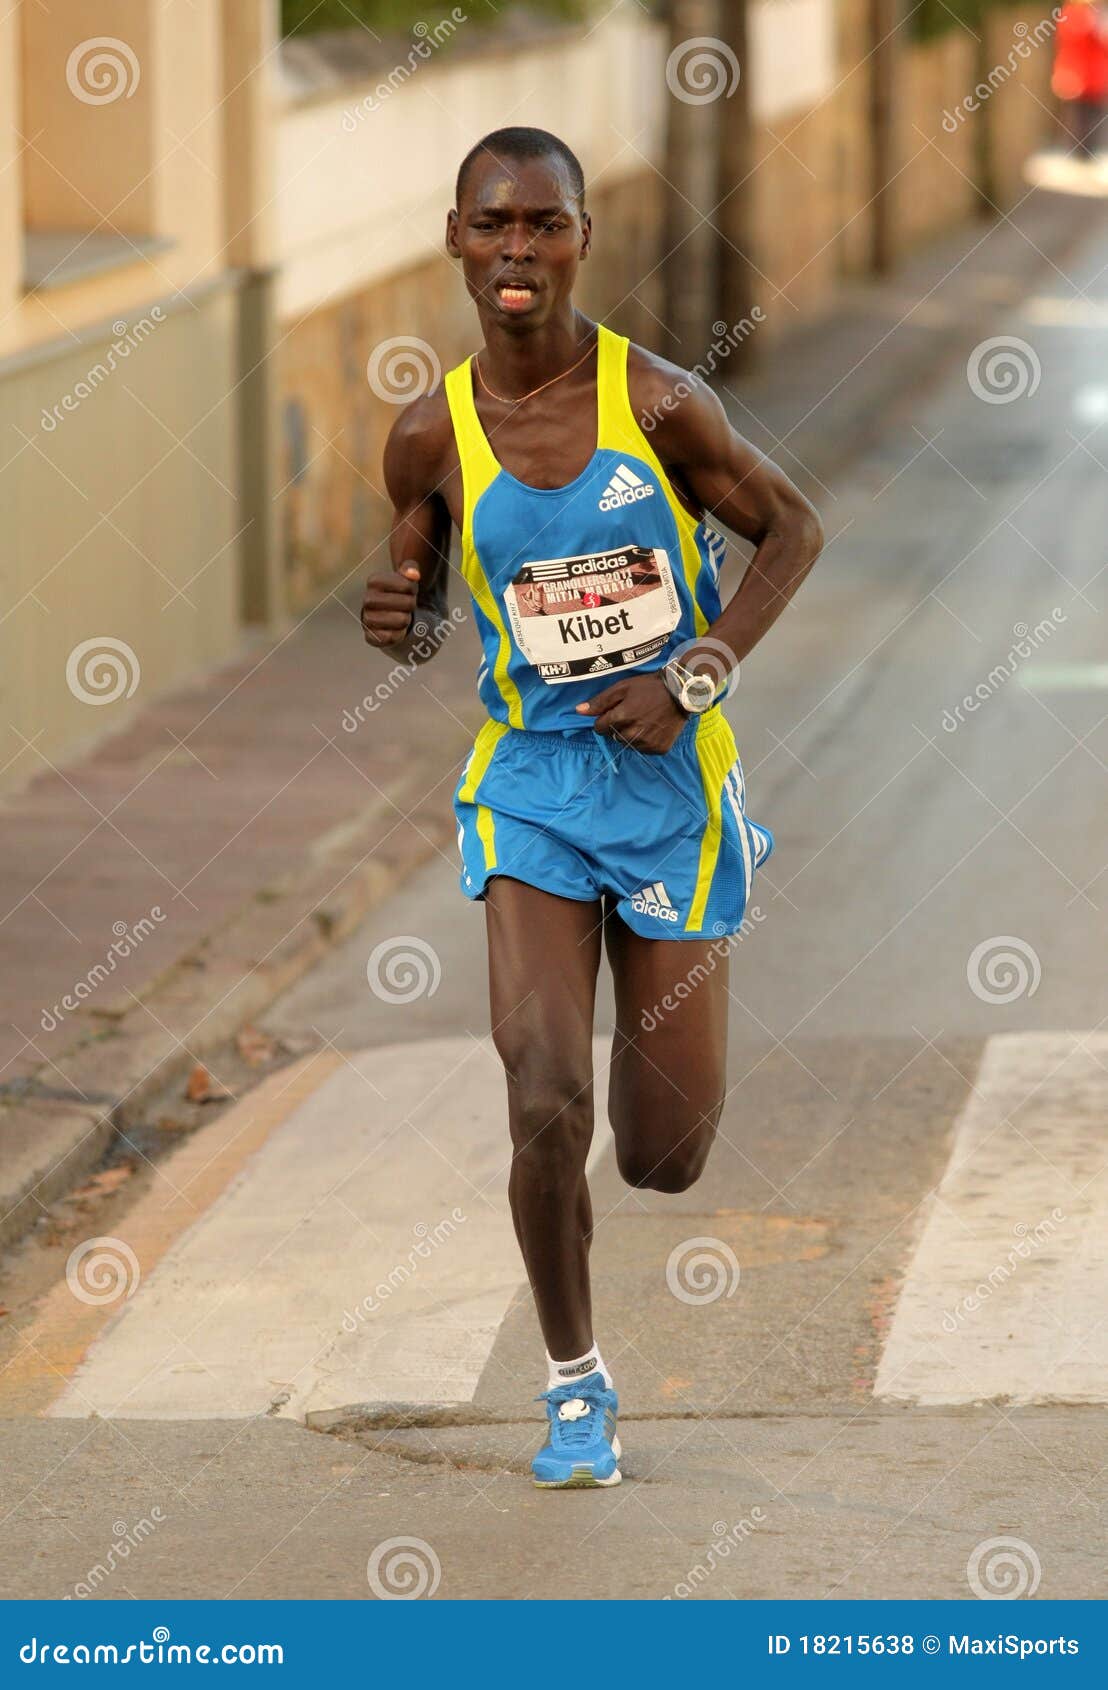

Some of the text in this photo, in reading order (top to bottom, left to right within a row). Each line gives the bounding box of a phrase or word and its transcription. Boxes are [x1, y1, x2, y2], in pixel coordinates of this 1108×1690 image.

[599, 484, 654, 511] adidas
[571, 555, 629, 574] adidas
[546, 588, 581, 603] MITJA
[557, 608, 634, 644] Kibet
[596, 644, 604, 653] 3
[631, 900, 679, 922] didas
